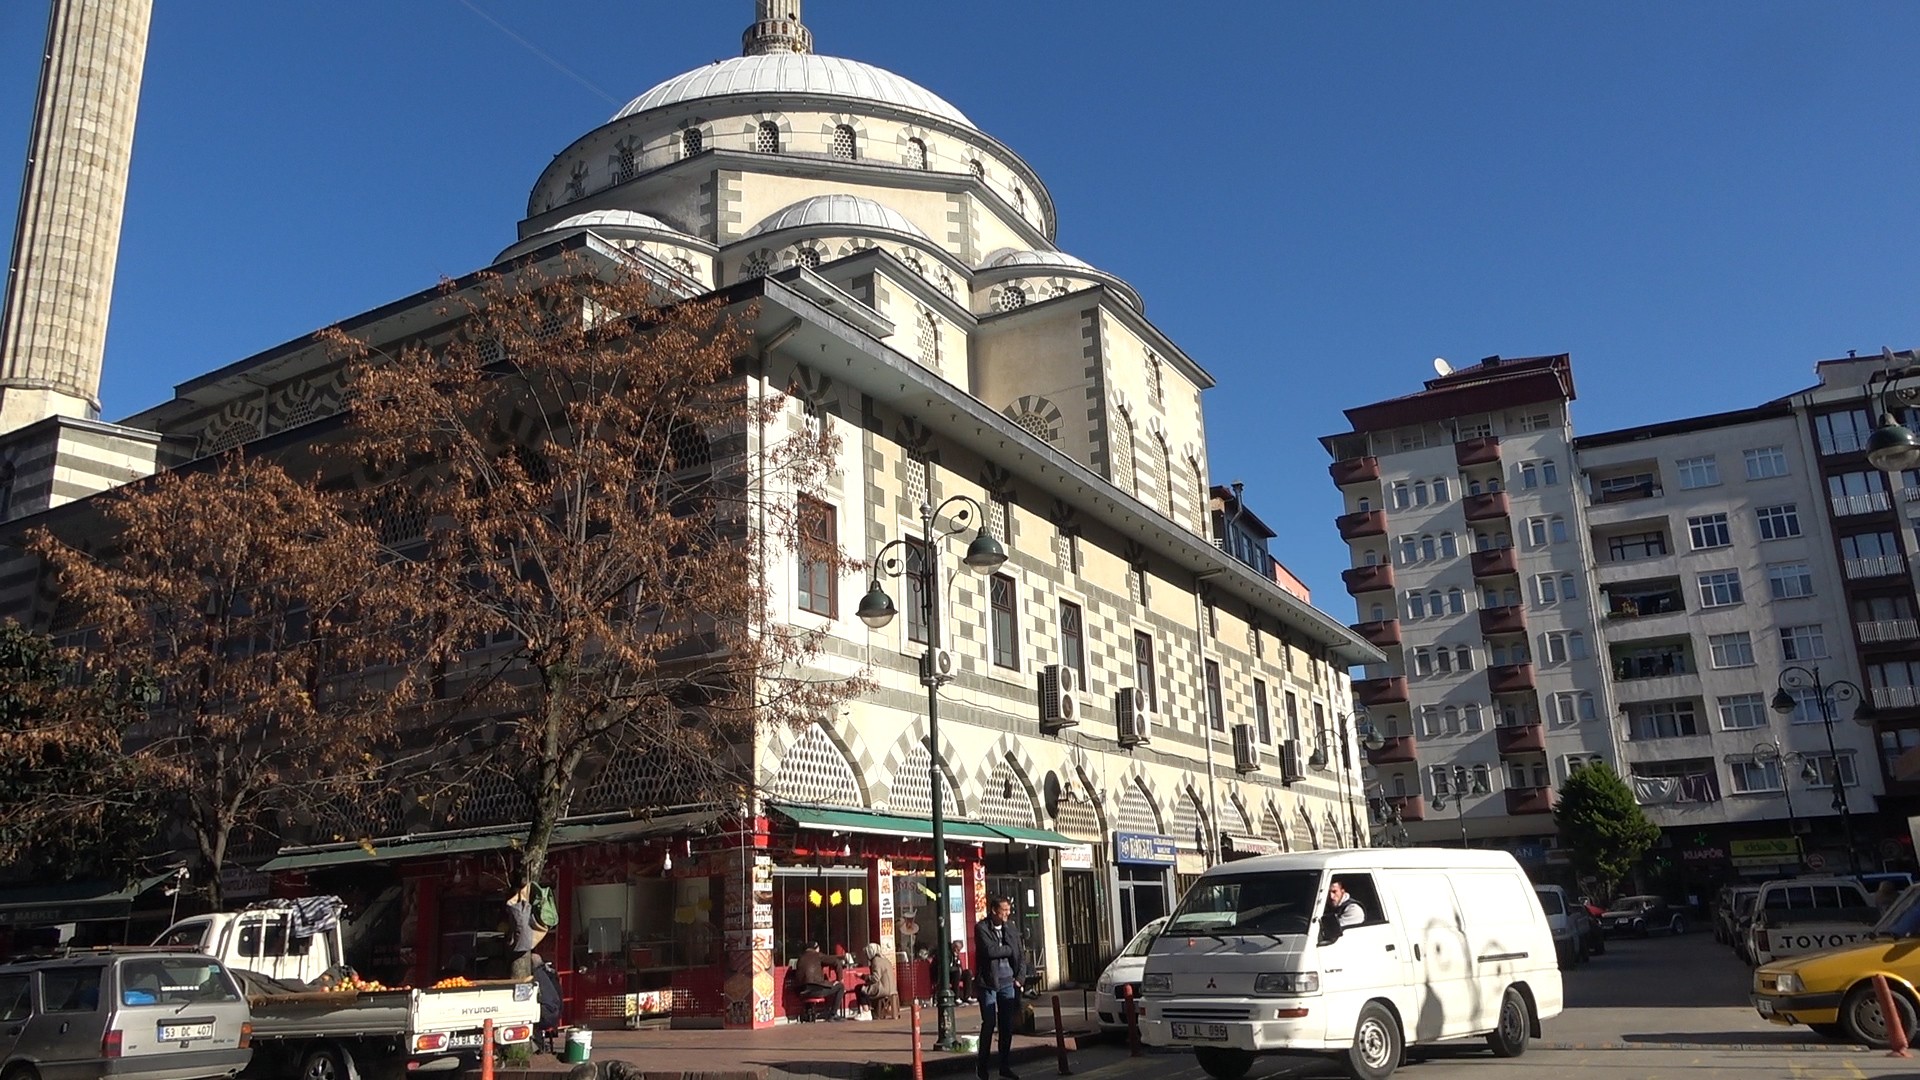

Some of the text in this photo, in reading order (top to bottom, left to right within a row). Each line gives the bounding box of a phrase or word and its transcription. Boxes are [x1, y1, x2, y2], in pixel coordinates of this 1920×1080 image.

[1682, 848, 1725, 860] KUAFÖR
[461, 1006, 499, 1015] HYUNDAI
[165, 1028, 176, 1038] 53
[197, 1025, 211, 1036] 407
